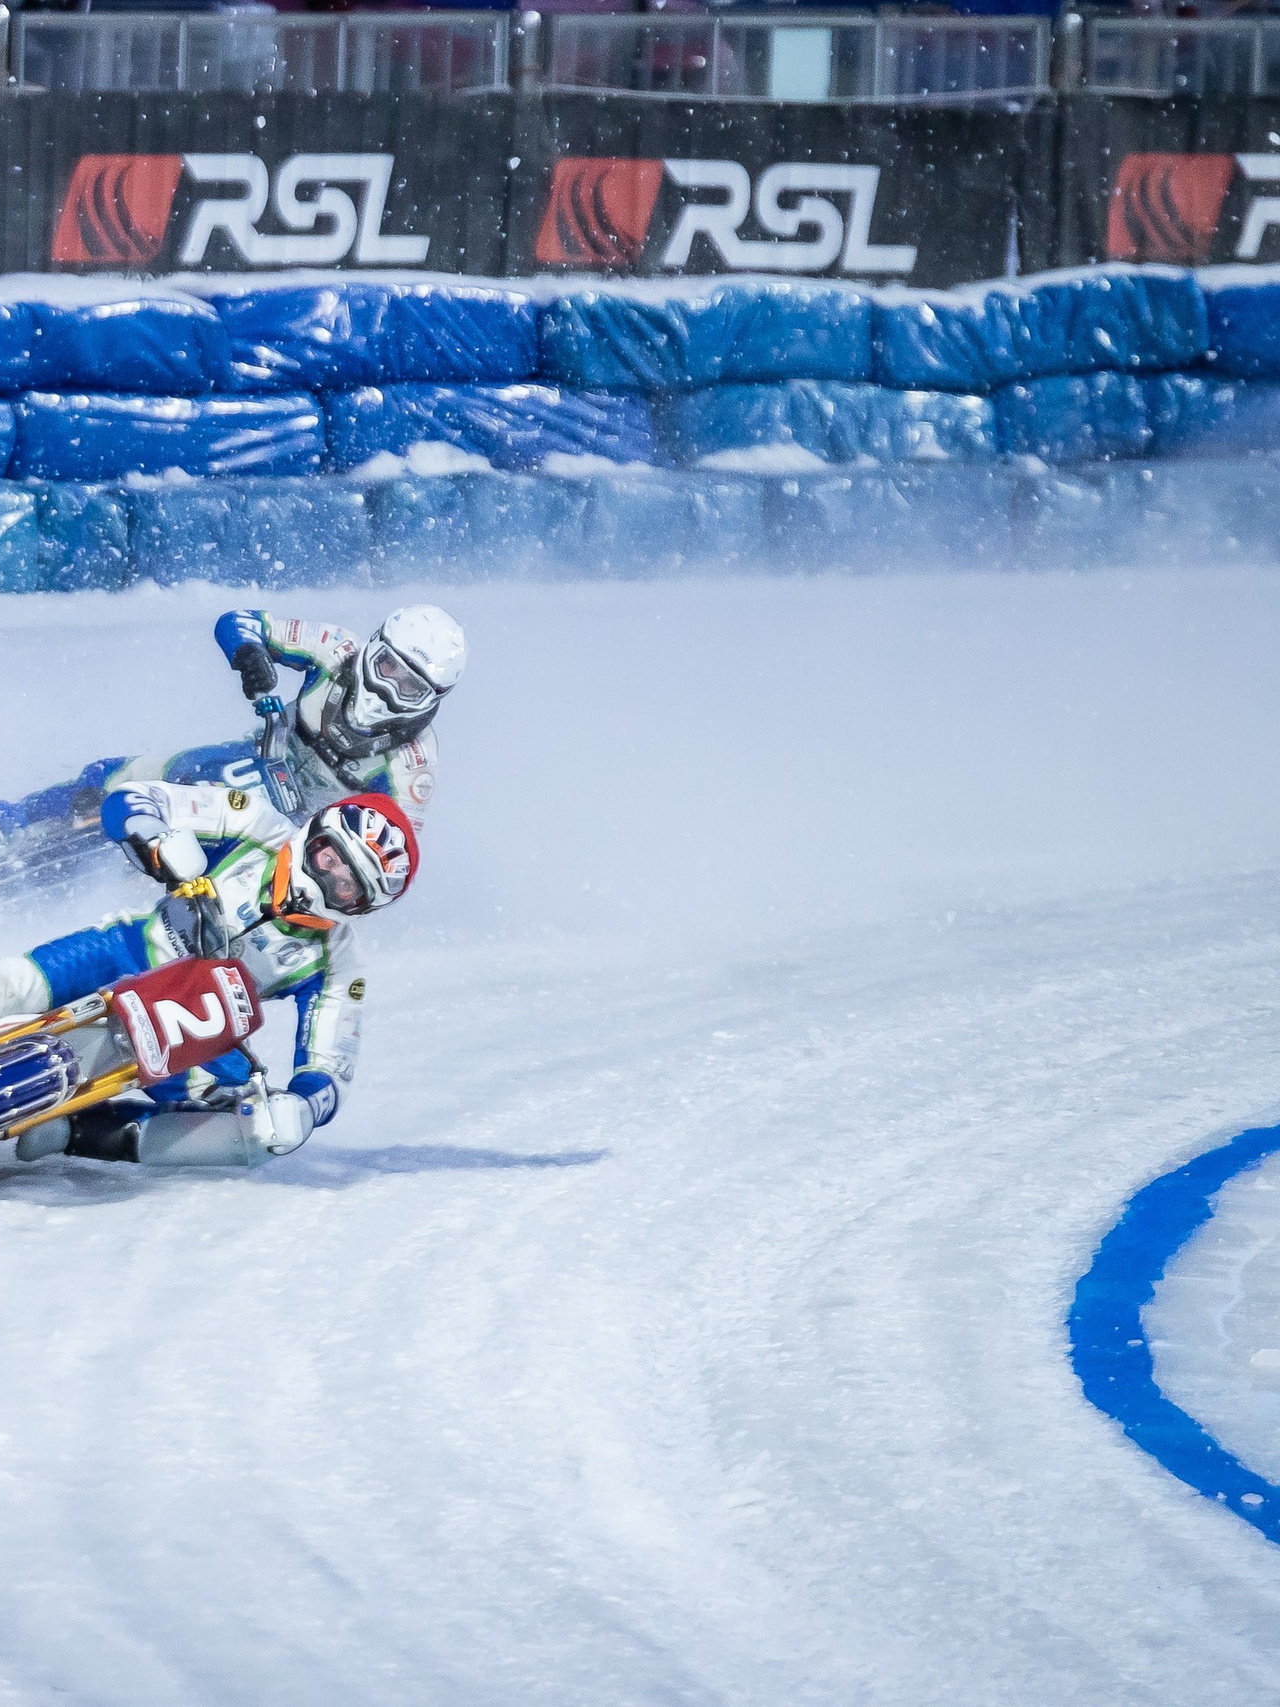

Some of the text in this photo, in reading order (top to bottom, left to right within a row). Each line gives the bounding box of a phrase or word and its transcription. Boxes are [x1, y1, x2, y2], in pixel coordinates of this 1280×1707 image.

[181, 152, 430, 267] RSL
[663, 158, 918, 274] RSL
[153, 992, 226, 1046] 2
